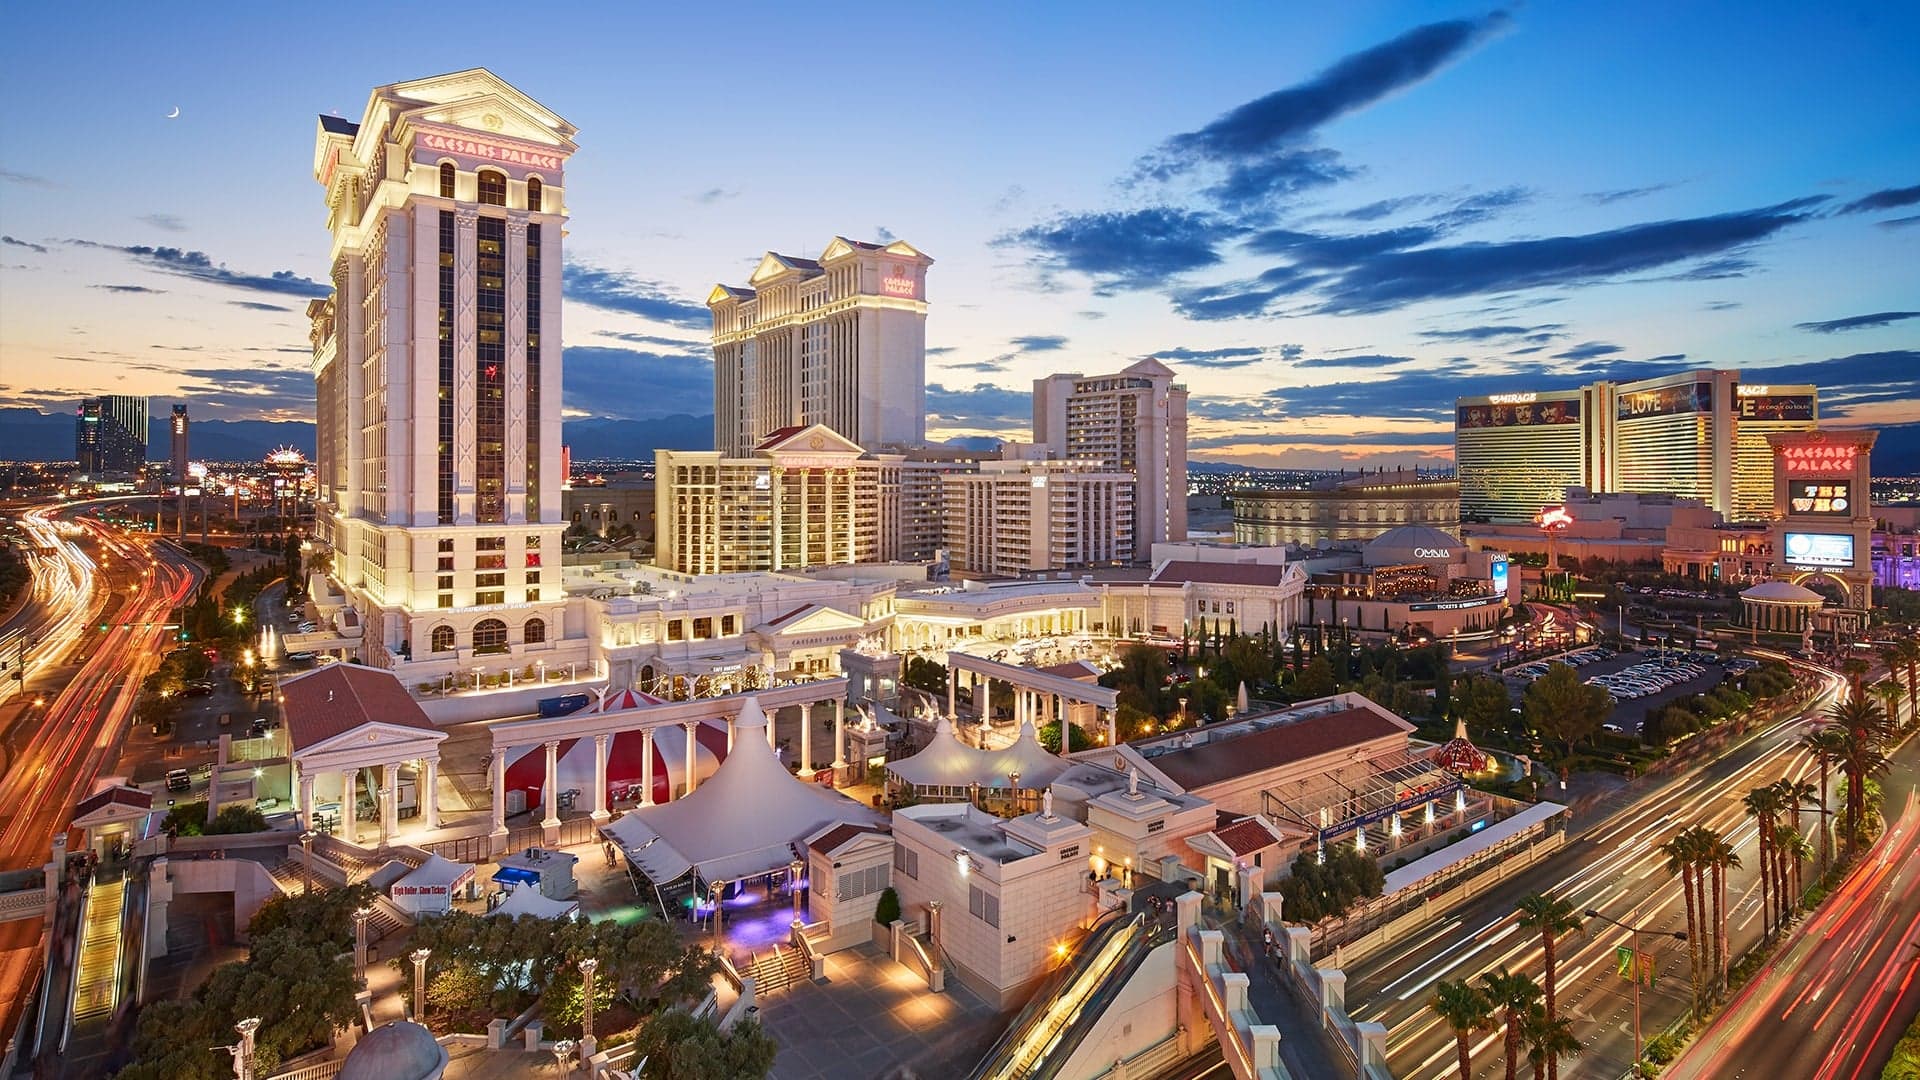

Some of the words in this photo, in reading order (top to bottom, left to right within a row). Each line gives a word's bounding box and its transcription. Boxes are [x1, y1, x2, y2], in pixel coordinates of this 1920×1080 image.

[424, 134, 496, 158] CAESARS
[501, 148, 558, 169] PALACE
[1500, 392, 1537, 404] MIRAGE
[1631, 393, 1662, 415] LOVE
[1783, 446, 1857, 458] CAESARS
[1787, 459, 1852, 471] PALACE
[1804, 485, 1847, 498] THE
[1791, 497, 1848, 512] WHO
[1414, 547, 1450, 558] OMNIA
[1794, 565, 1818, 573] NOBU
[1821, 566, 1845, 574] HOTEL
[791, 637, 823, 647] CAESARS
[825, 633, 853, 643] PALACE
[419, 887, 431, 895] Show
[431, 886, 446, 895] Tickets
